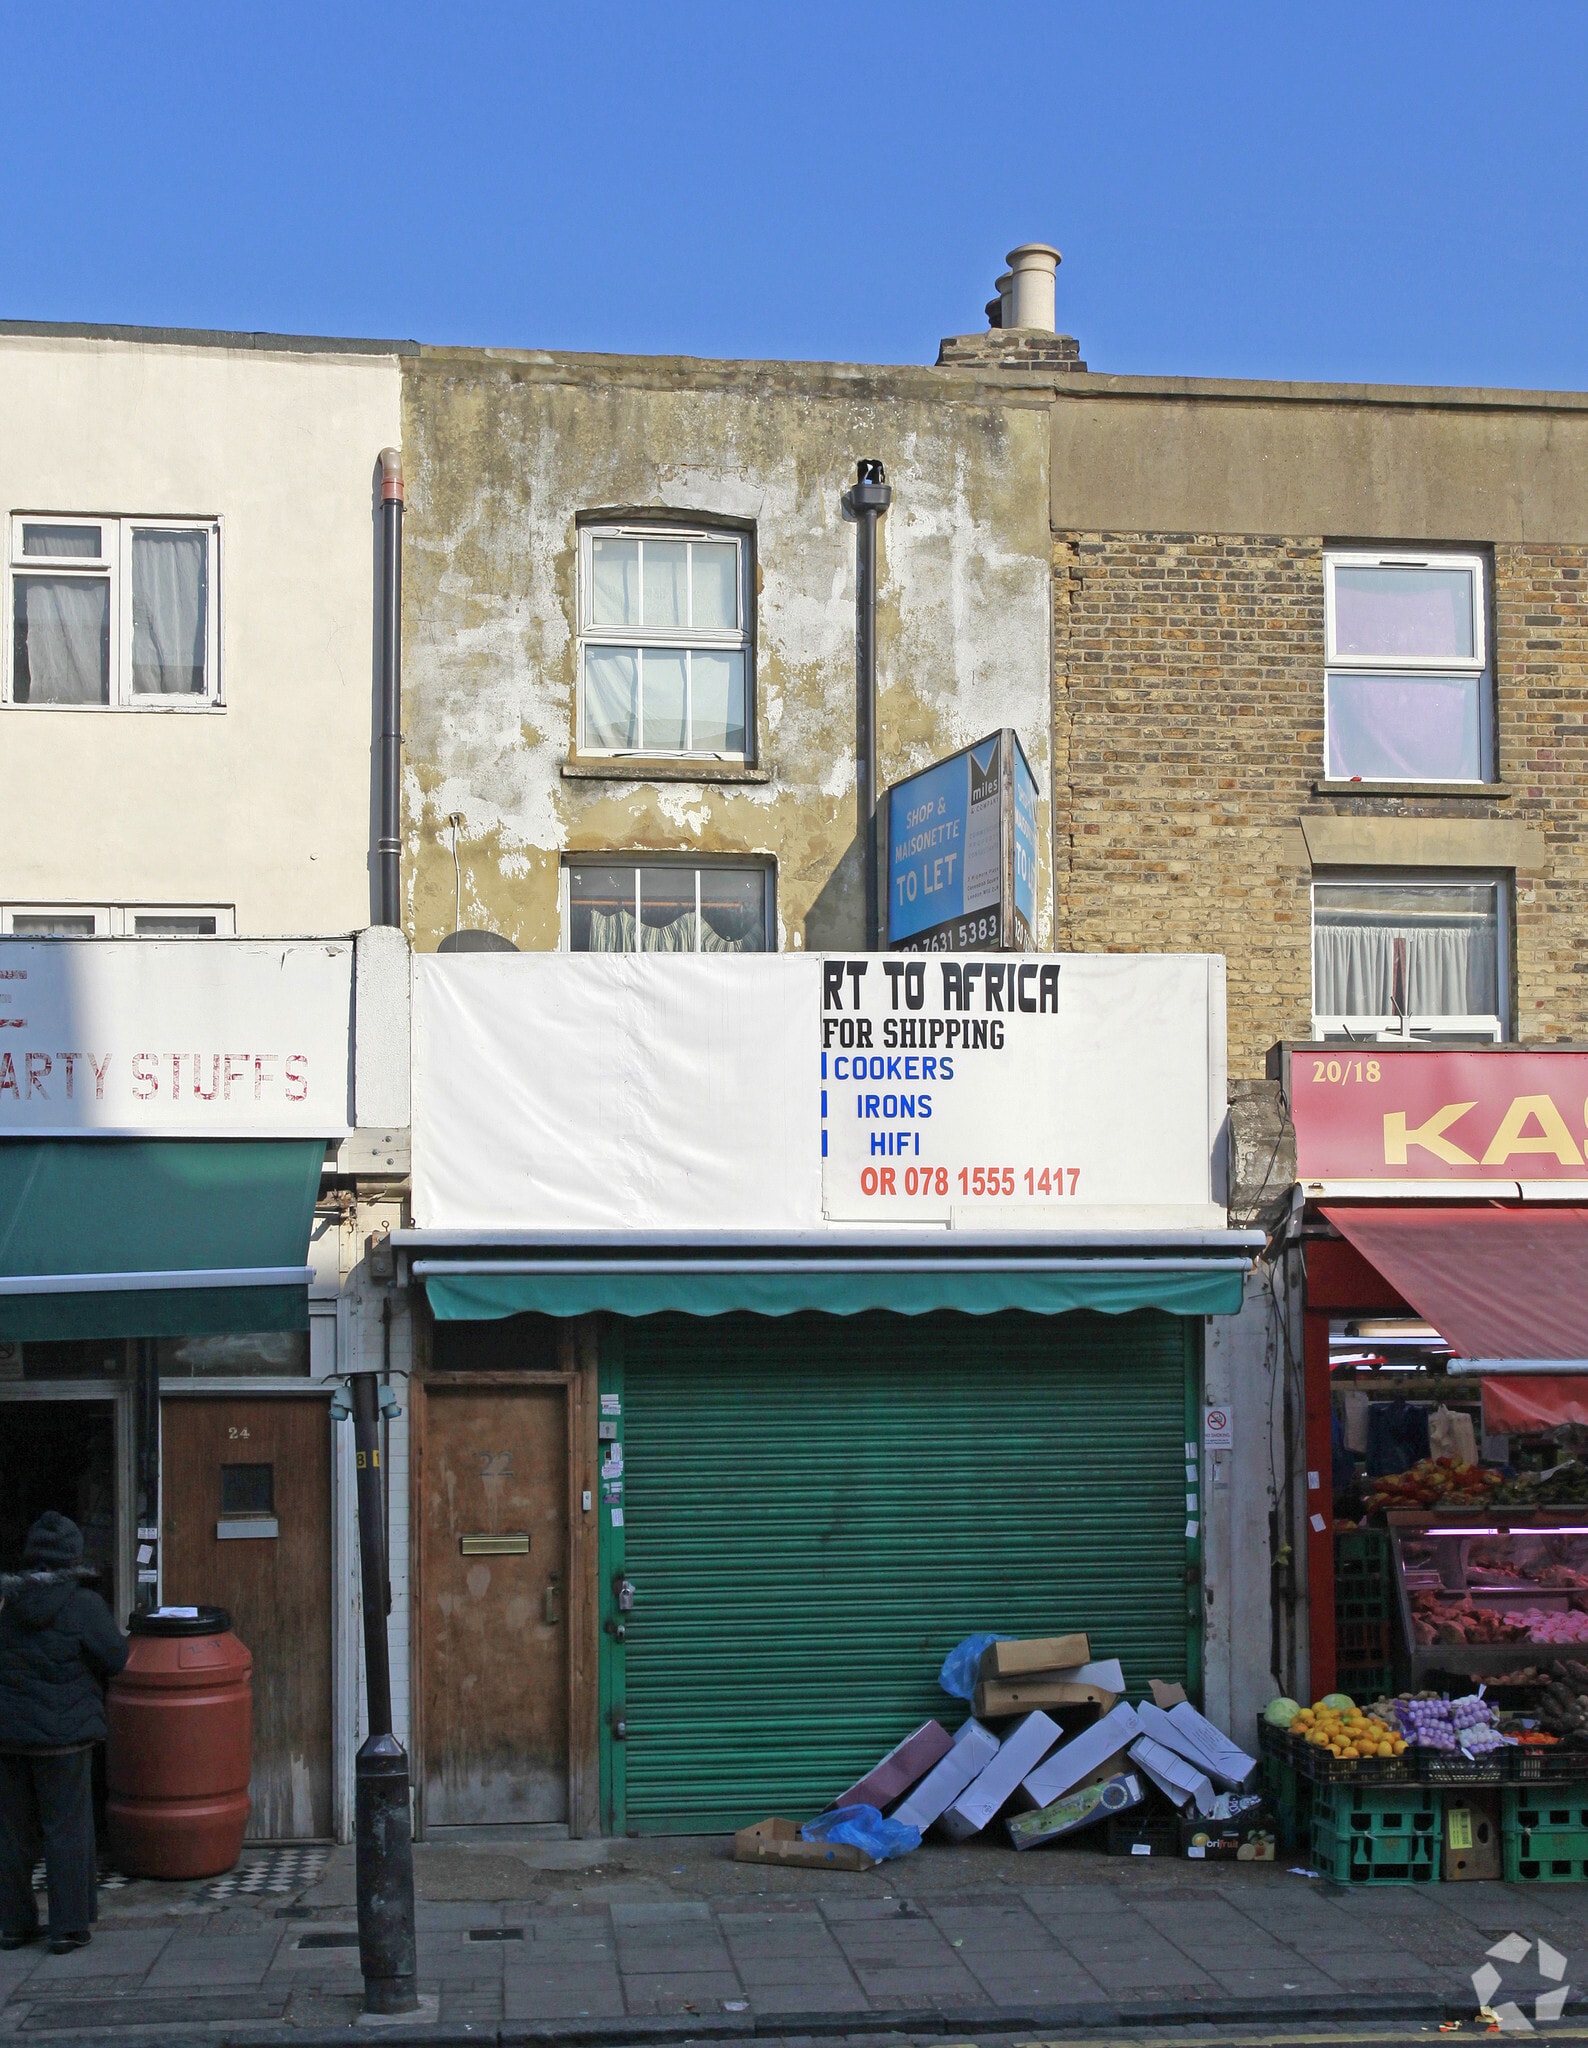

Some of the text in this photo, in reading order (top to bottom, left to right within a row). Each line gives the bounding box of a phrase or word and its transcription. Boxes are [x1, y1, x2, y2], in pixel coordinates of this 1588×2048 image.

[972, 779, 998, 801] miles
[906, 796, 946, 829] SHOP &
[895, 819, 960, 864] MAISONETTE
[1016, 841, 1027, 881] TO
[896, 852, 958, 906] TO LET
[923, 930, 953, 952] 7631
[959, 915, 997, 947] 5383
[823, 960, 1061, 1014] RT TO AFRICA
[823, 1018, 1005, 1050] FOR SHIPPING
[0, 1052, 308, 1101] ARTY STUFFS
[834, 1056, 954, 1080] COOKERS
[1312, 1060, 1381, 1086] 20/18
[857, 1094, 932, 1118] IRONS
[870, 1132, 920, 1156] HIFI
[1383, 1094, 1588, 1165] KA
[860, 1166, 1081, 1196] OR 078 1555 1417
[228, 1427, 250, 1440] 24
[479, 1452, 514, 1476] 22
[1206, 1839, 1239, 1849] orifruit
